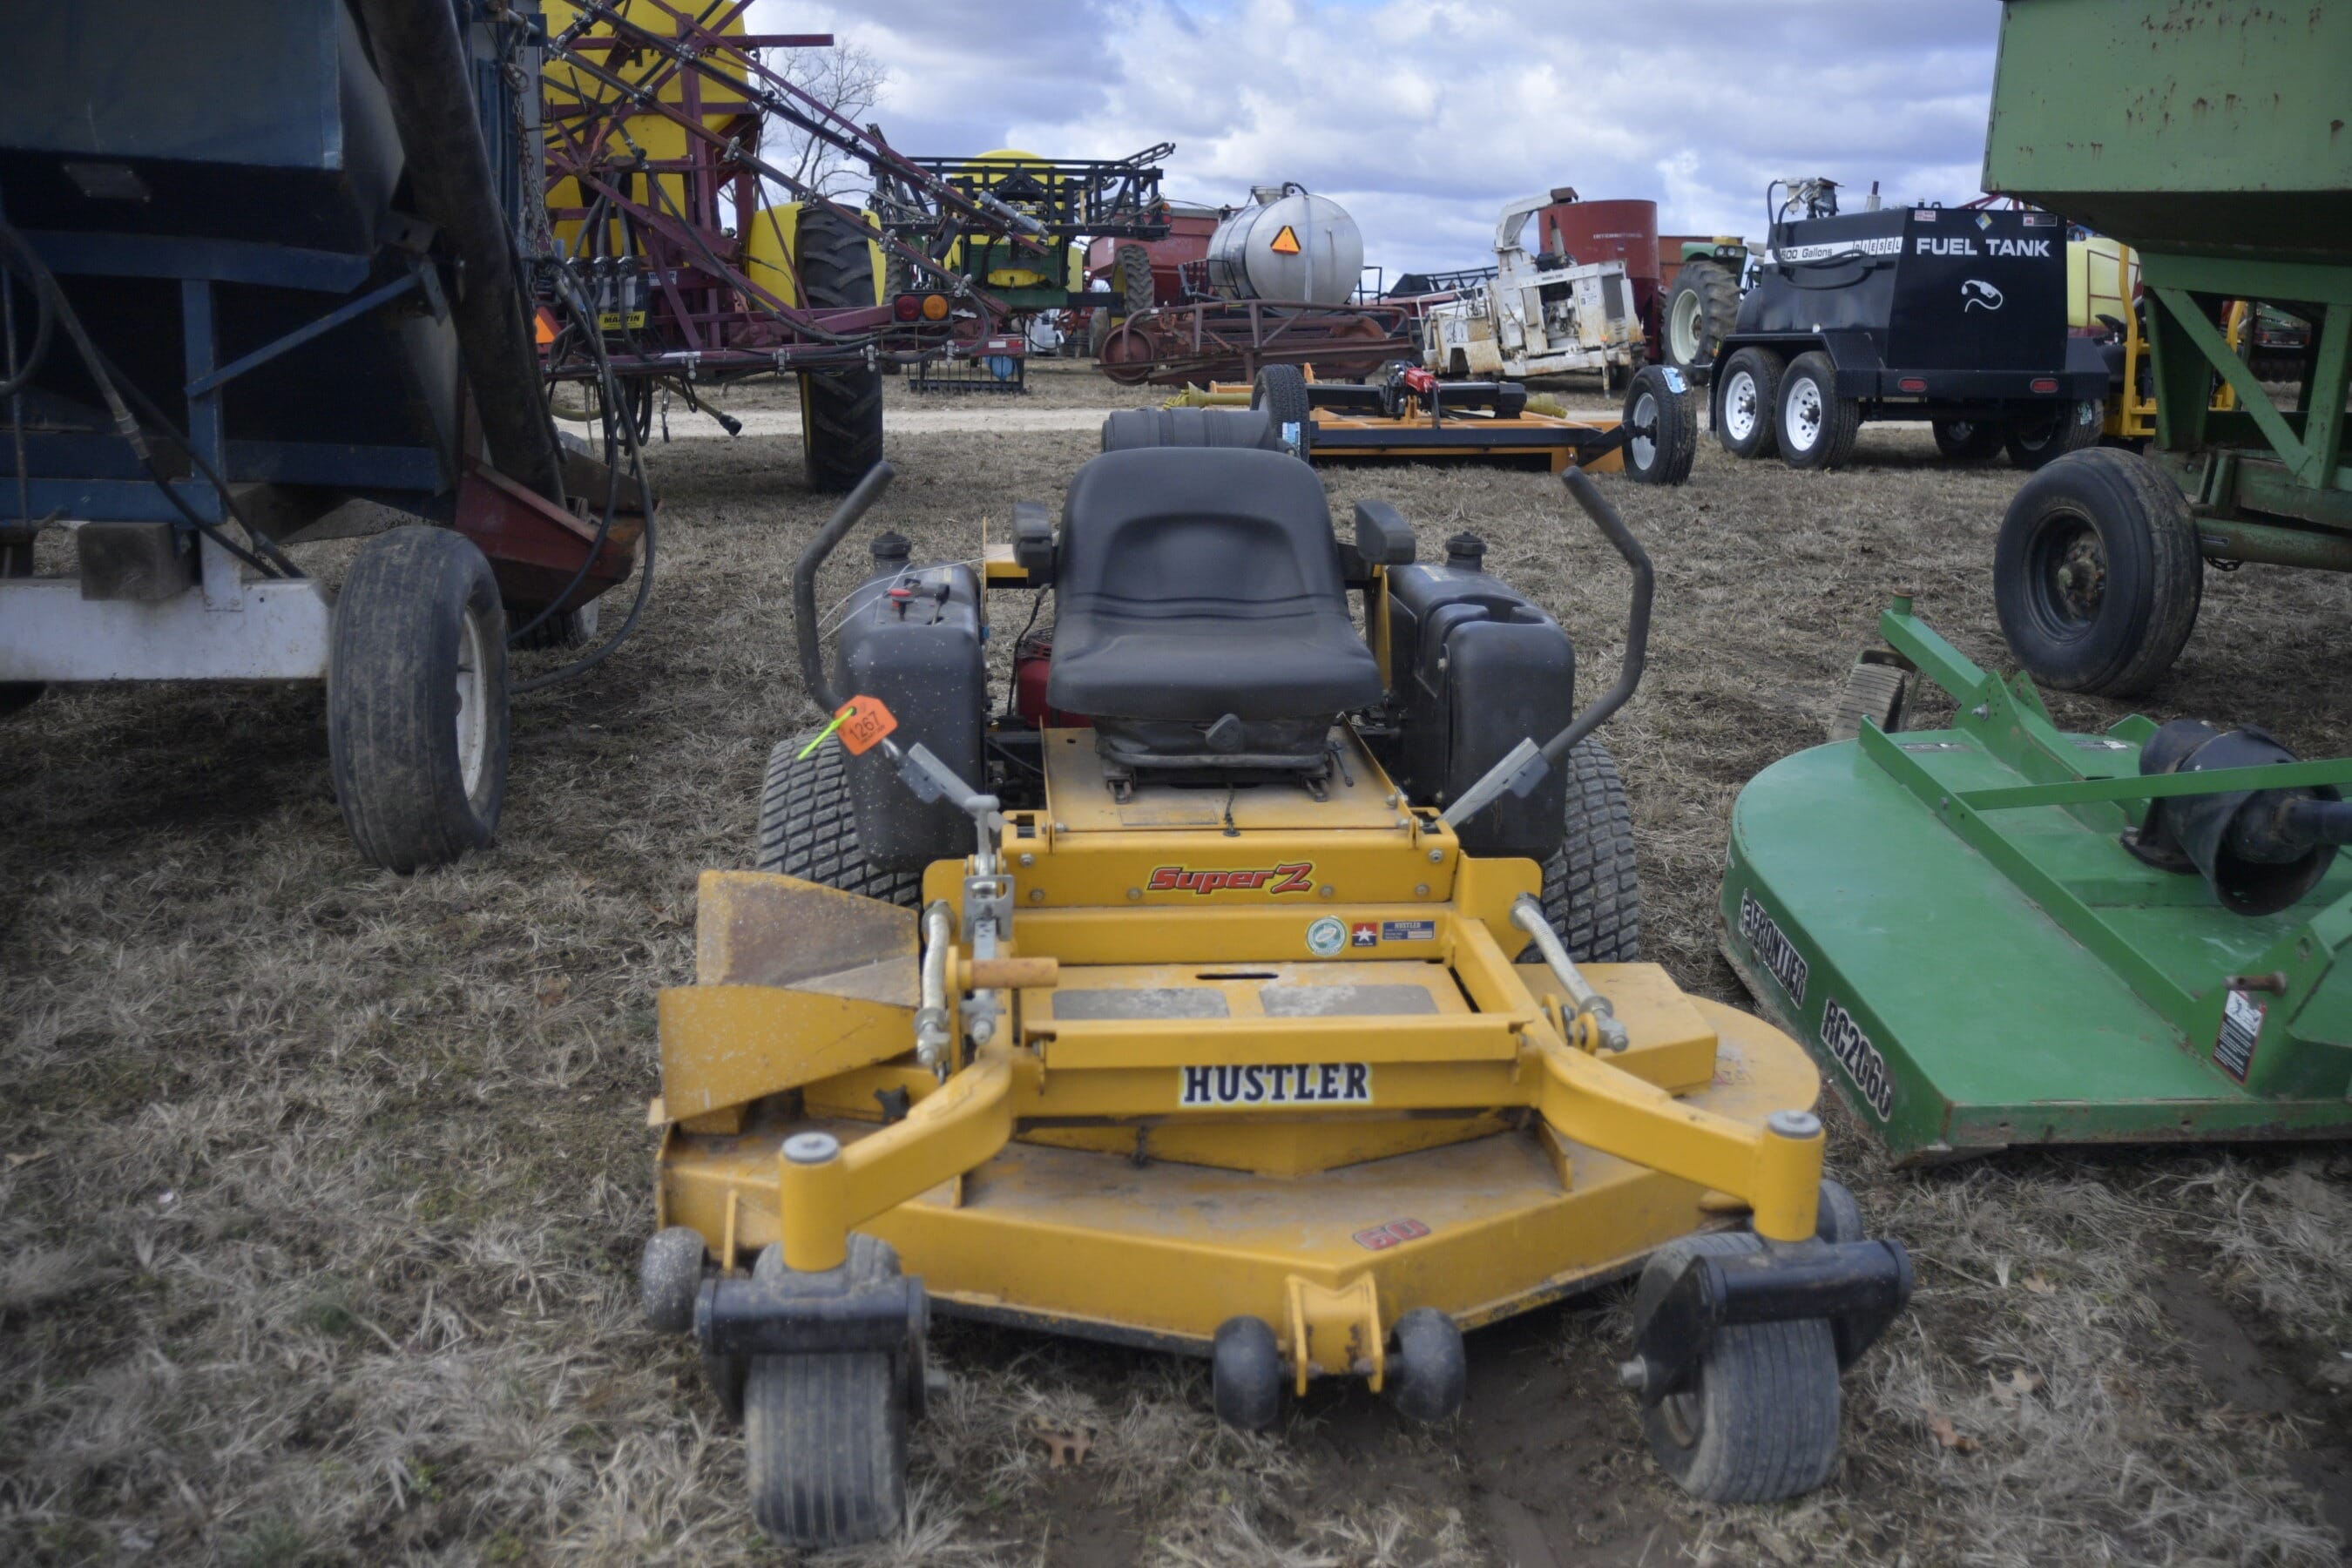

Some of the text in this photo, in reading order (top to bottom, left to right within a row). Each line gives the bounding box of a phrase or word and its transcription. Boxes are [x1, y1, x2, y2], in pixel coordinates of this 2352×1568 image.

[1801, 247, 1833, 259] Gallons
[1916, 238, 2051, 257] FUEL TANK
[604, 314, 640, 324] MATIN
[849, 711, 882, 740] 1267
[1183, 1063, 1368, 1103] HUSTLER
